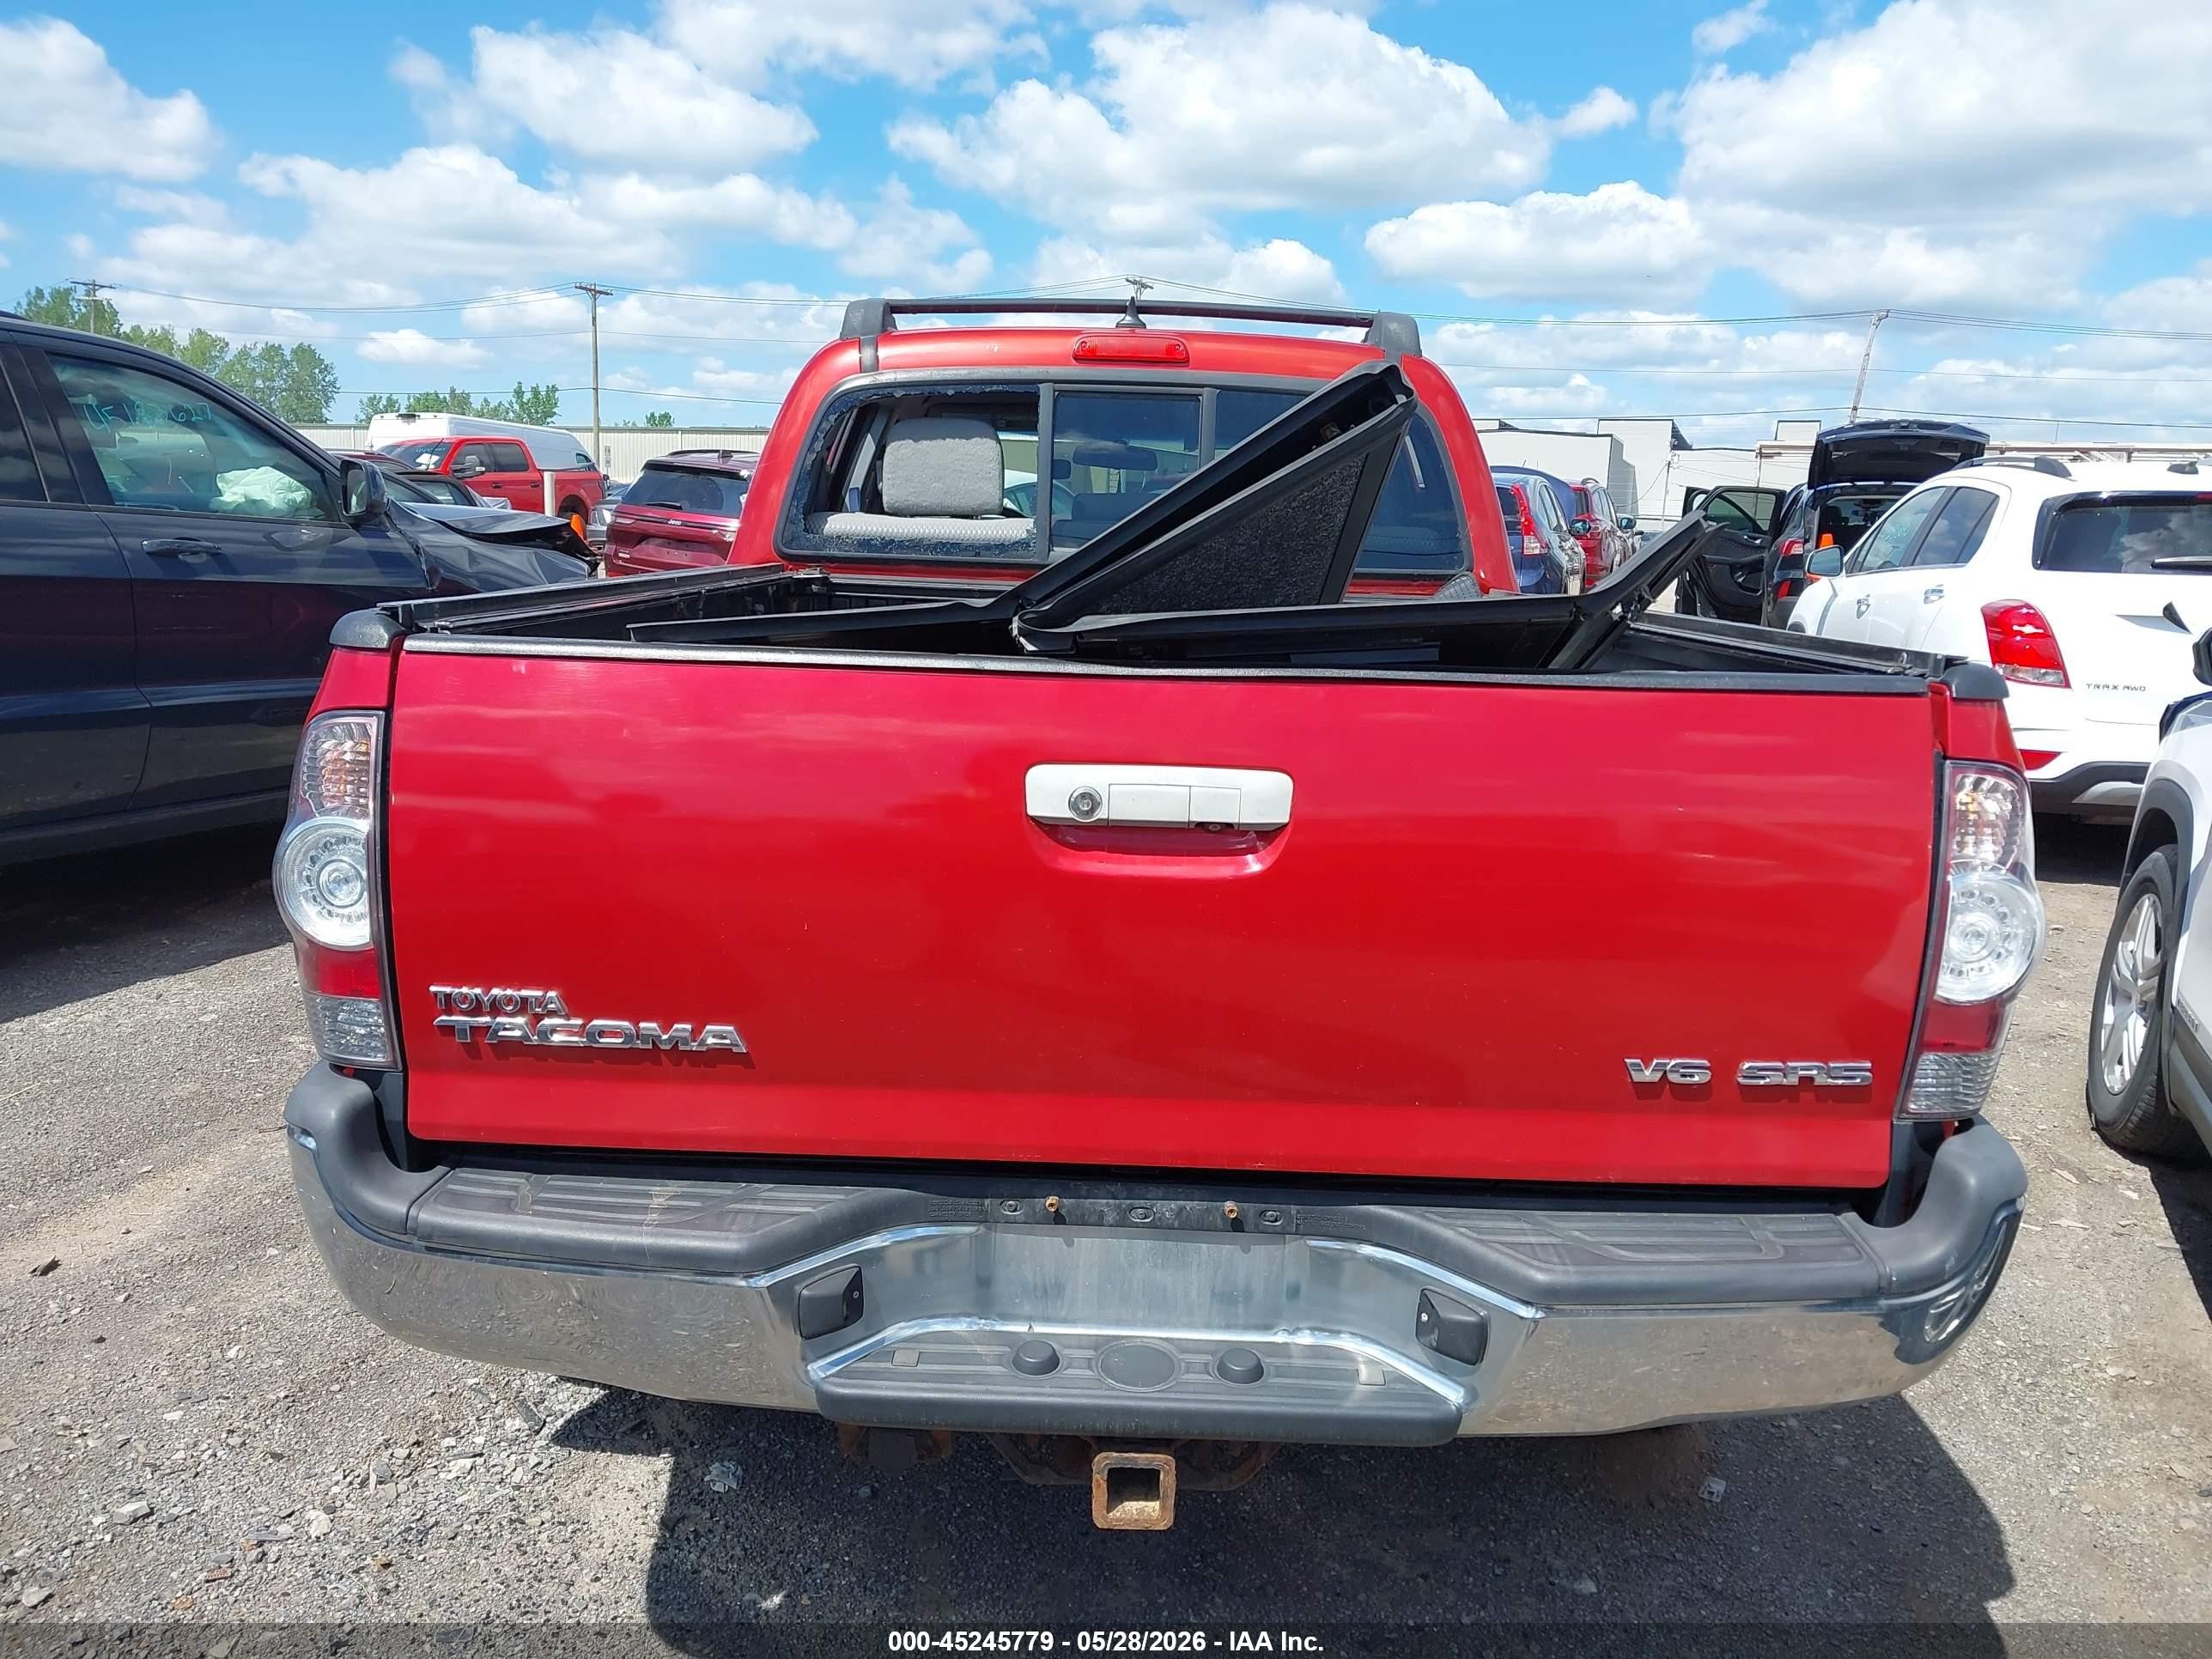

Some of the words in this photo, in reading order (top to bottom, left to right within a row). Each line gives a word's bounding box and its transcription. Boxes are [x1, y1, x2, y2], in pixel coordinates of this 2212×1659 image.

[429, 984, 566, 1014] TOYOTA
[433, 1015, 749, 1054] TACOMA
[1624, 1058, 1712, 1085] V6
[1736, 1060, 1873, 1086] SR5
